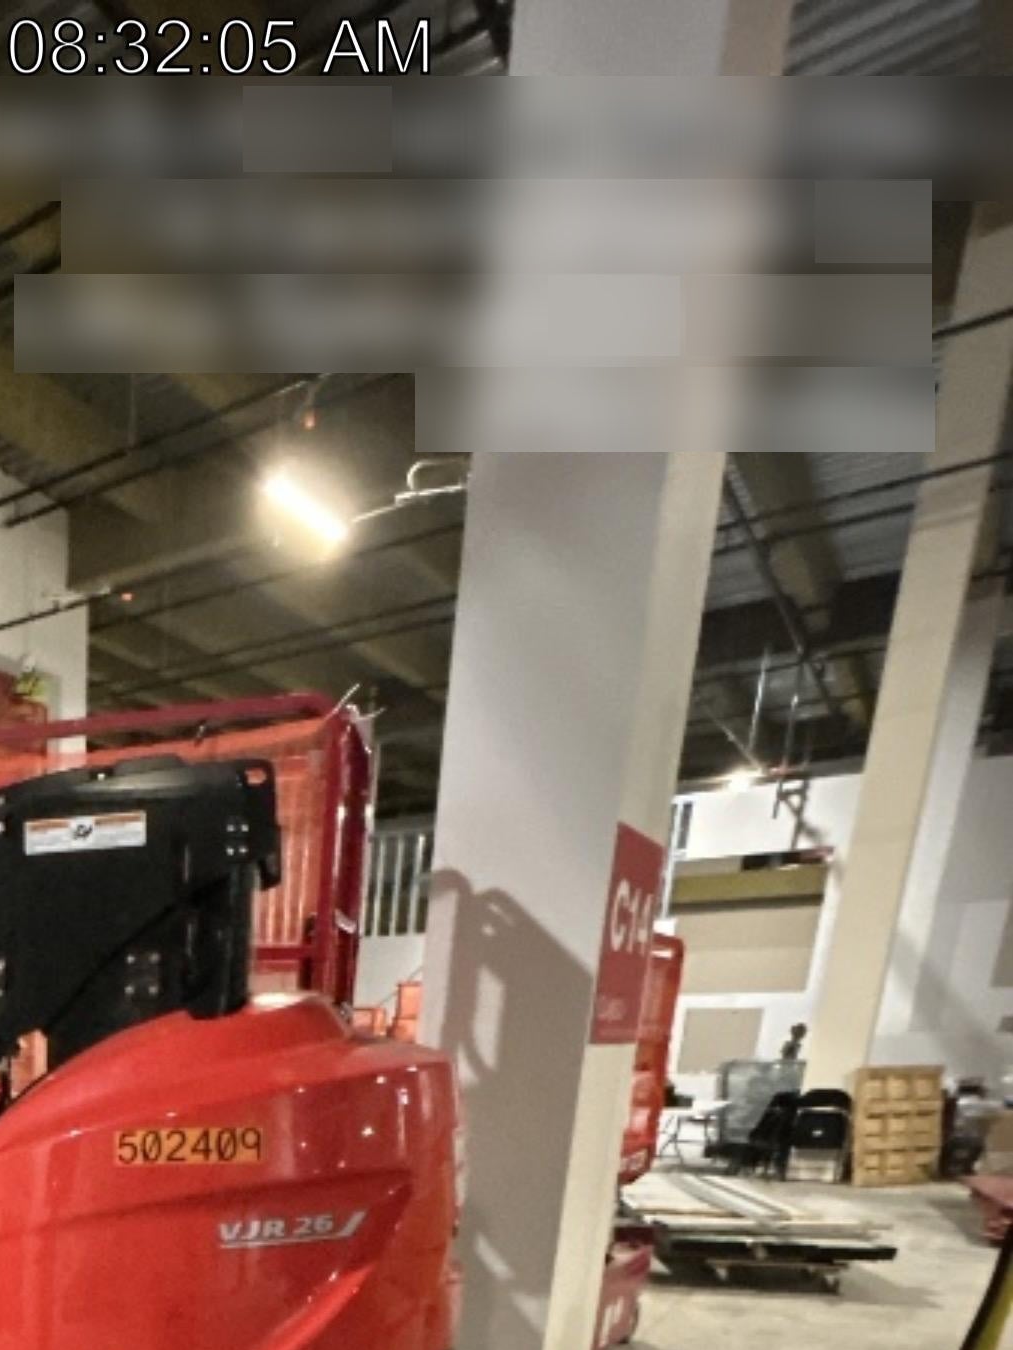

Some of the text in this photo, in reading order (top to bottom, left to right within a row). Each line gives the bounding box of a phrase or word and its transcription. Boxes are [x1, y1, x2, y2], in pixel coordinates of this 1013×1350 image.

[117, 1127, 262, 1163] 502409
[219, 1215, 334, 1241] VJR 26
